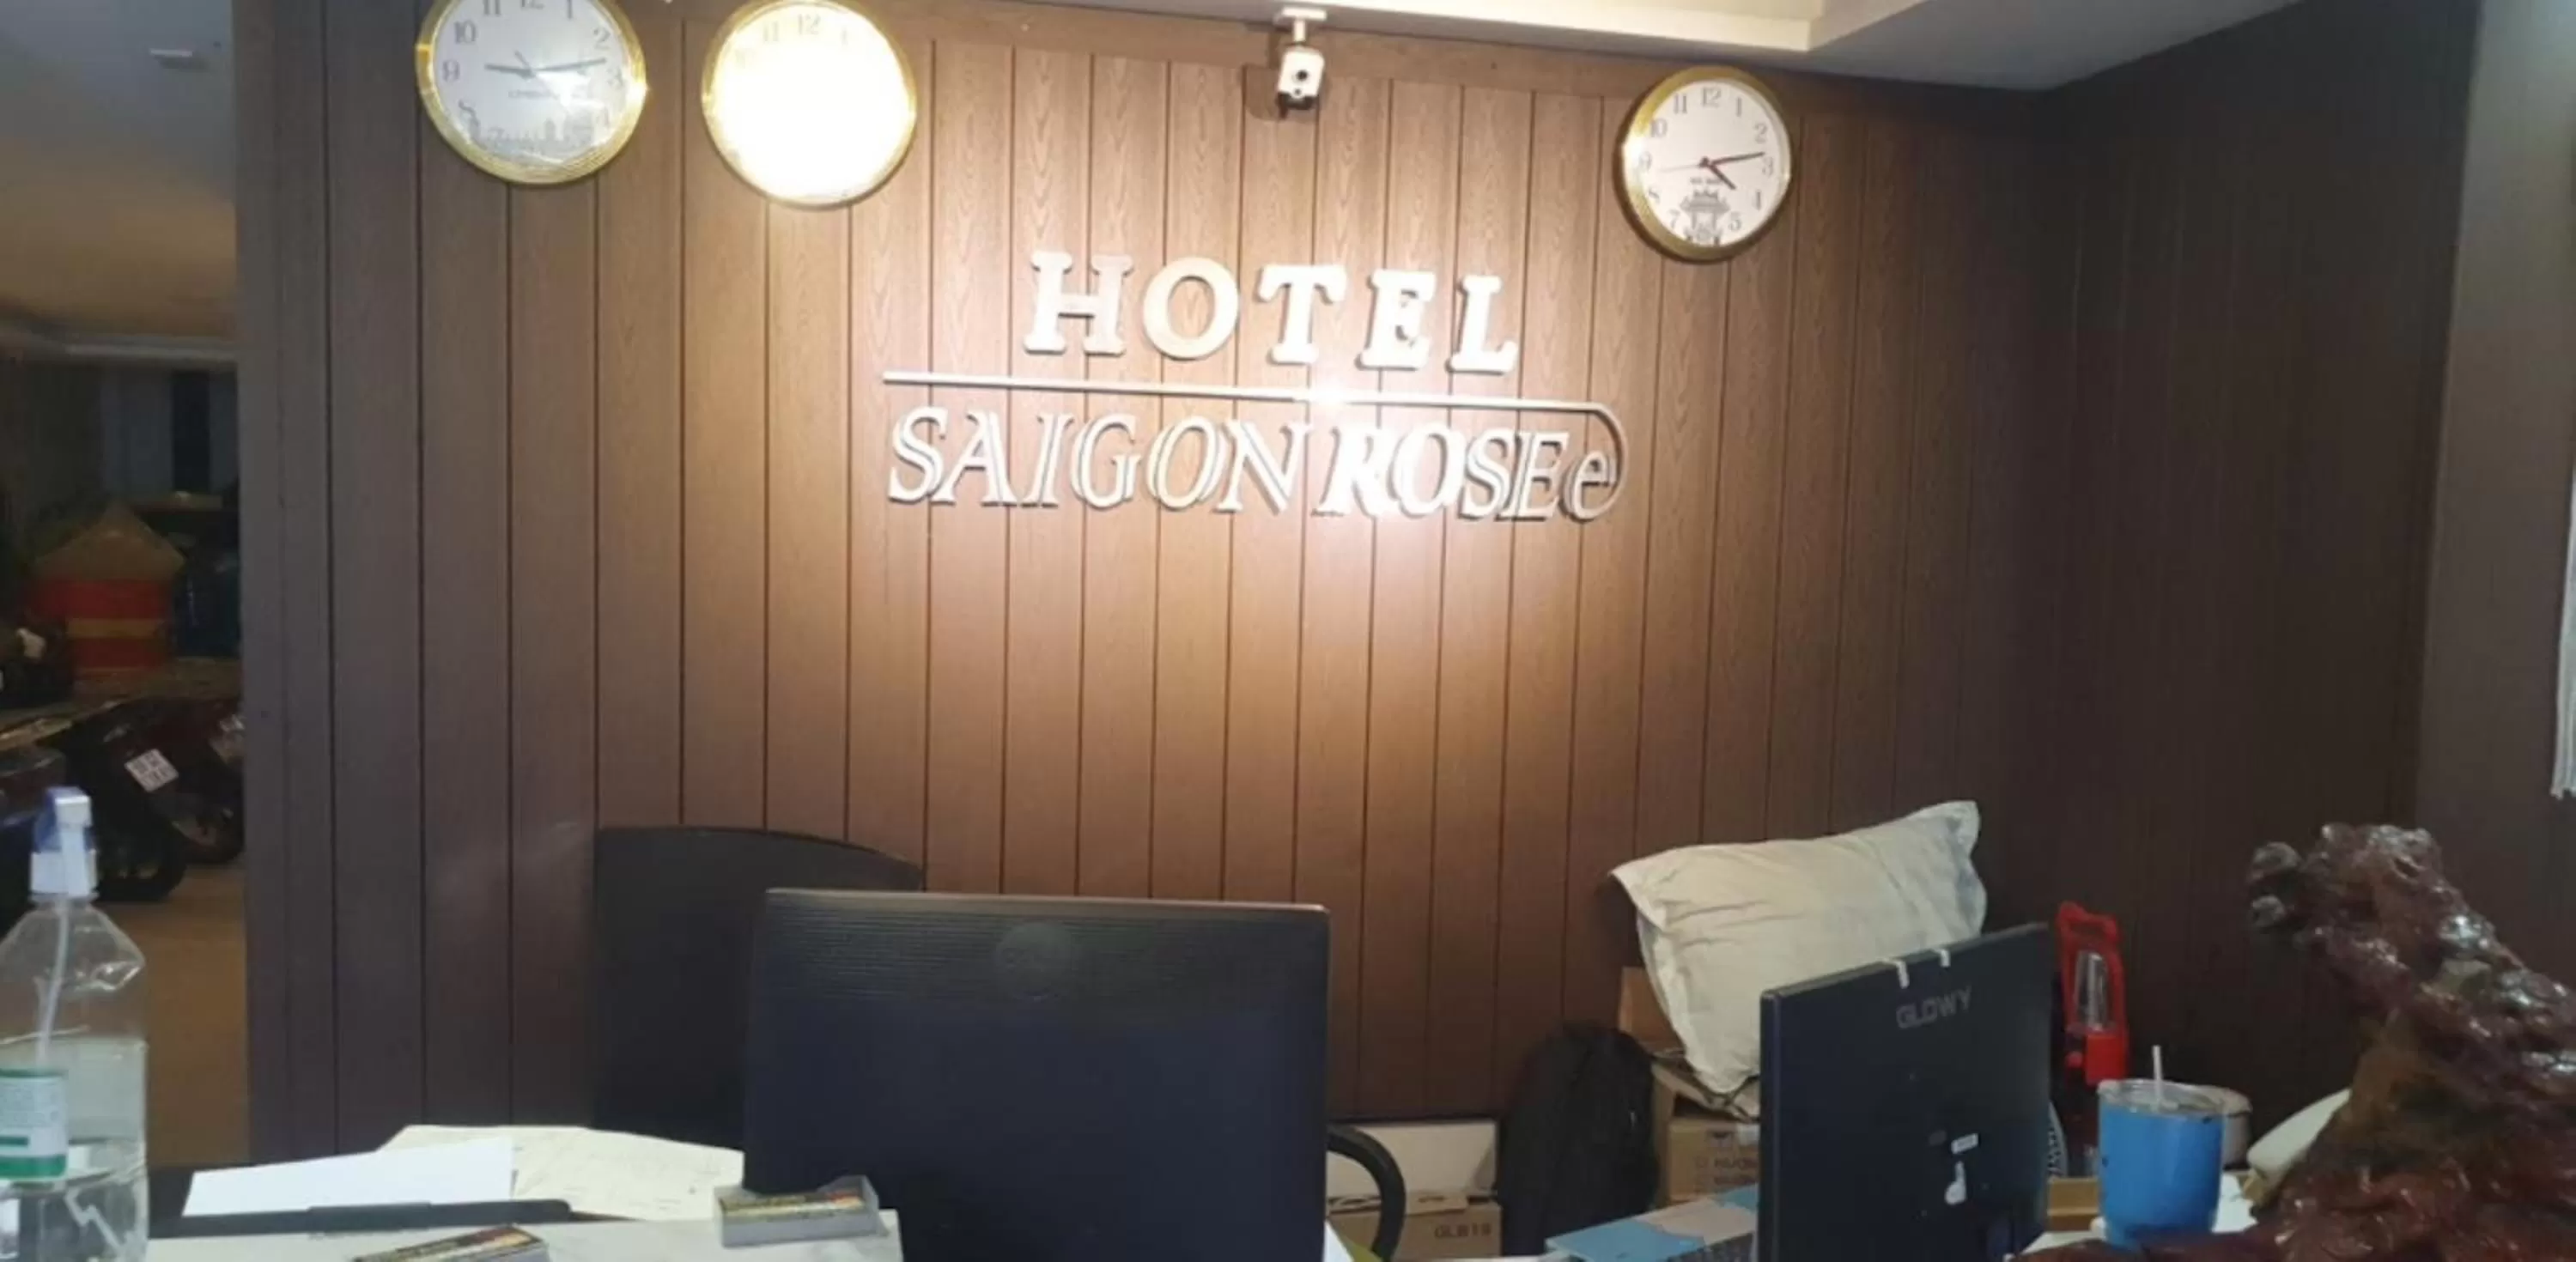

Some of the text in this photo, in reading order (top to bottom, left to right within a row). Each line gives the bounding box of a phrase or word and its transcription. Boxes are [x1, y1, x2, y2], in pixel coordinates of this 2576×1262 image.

[454, 21, 477, 44] 10
[593, 27, 611, 50] 2
[1674, 94, 1688, 114] 11
[1701, 88, 1722, 107] 12
[1651, 118, 1668, 137] 10
[1754, 123, 1768, 144] 2
[1024, 250, 1519, 373] HOTEL
[887, 405, 1313, 515] SAIGON
[1896, 985, 1972, 1028] GLOWY
